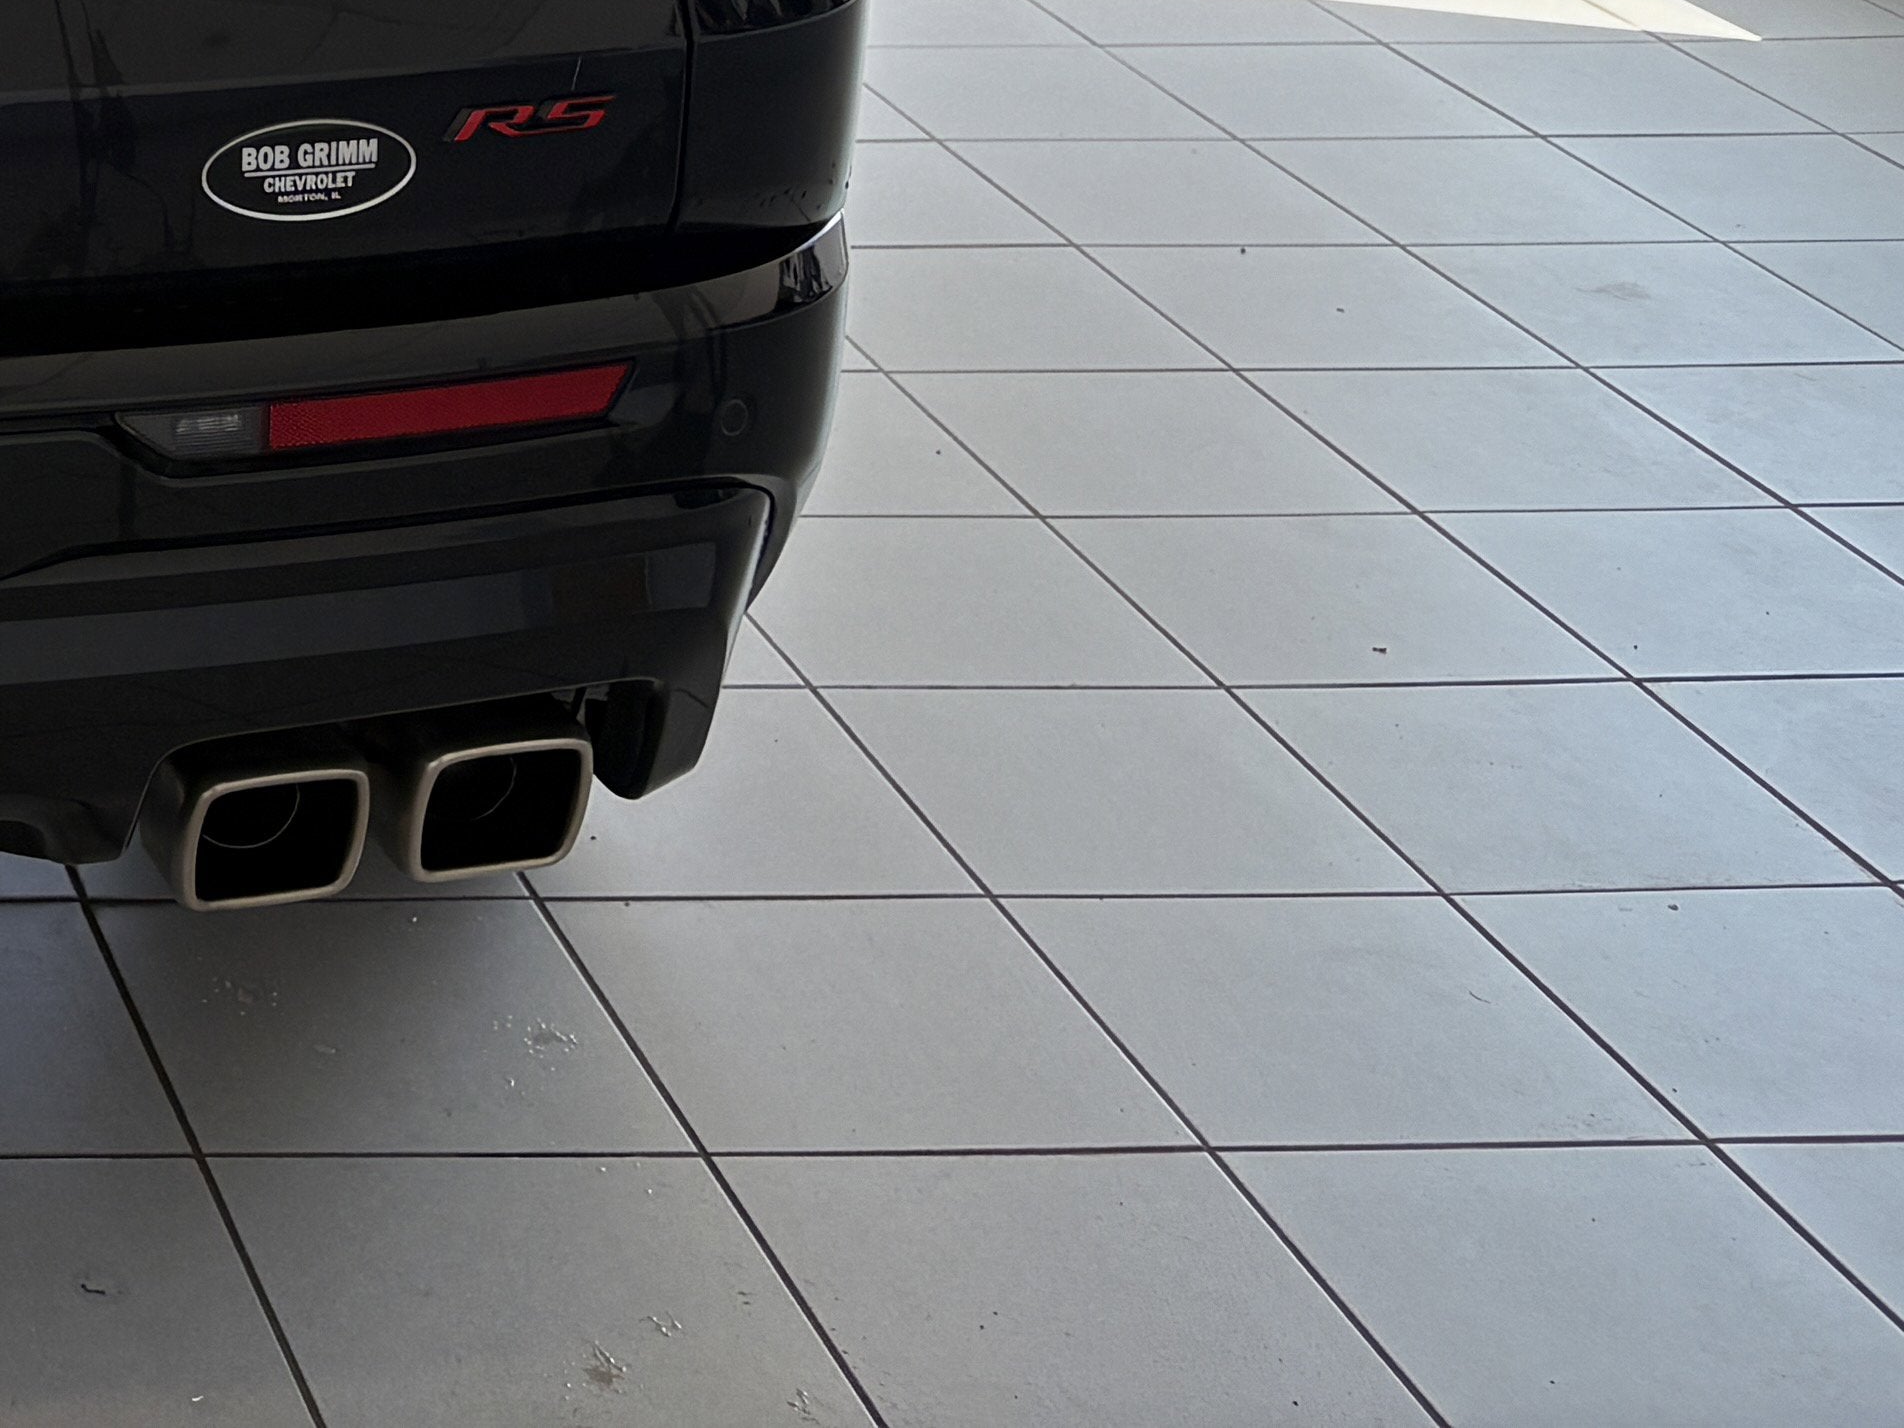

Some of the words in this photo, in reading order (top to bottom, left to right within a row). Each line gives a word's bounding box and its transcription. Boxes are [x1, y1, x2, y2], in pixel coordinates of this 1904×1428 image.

[442, 94, 617, 144] RS
[242, 145, 290, 171] BOB
[297, 138, 379, 168] GRIMM
[263, 171, 356, 193] CHEVROLET
